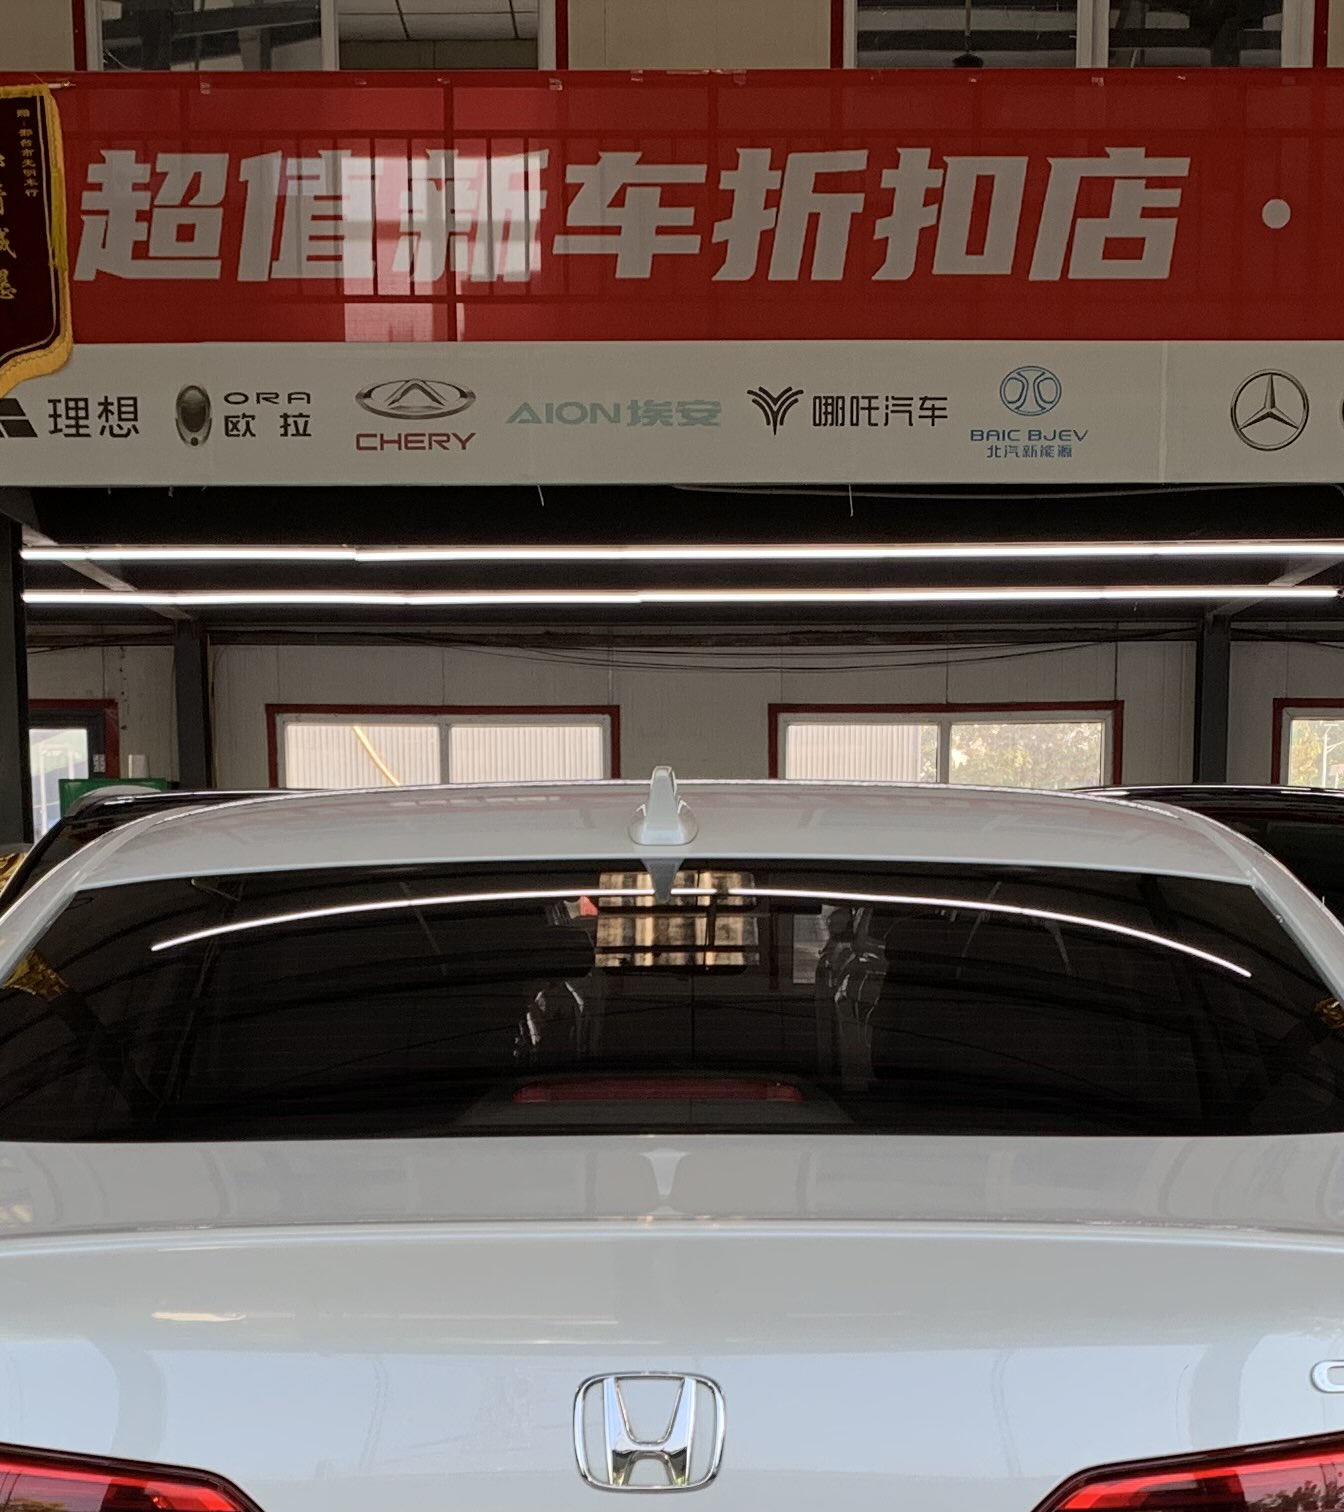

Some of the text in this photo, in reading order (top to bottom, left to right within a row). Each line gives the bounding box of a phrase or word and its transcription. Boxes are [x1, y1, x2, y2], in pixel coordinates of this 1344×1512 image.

[223, 392, 312, 405] ORA
[47, 395, 140, 439] 理想
[223, 412, 313, 438] 欧拉
[355, 432, 477, 451] CHERY
[970, 429, 1089, 442] BAIC BJEV
[986, 445, 1074, 459] 北汽新能源
